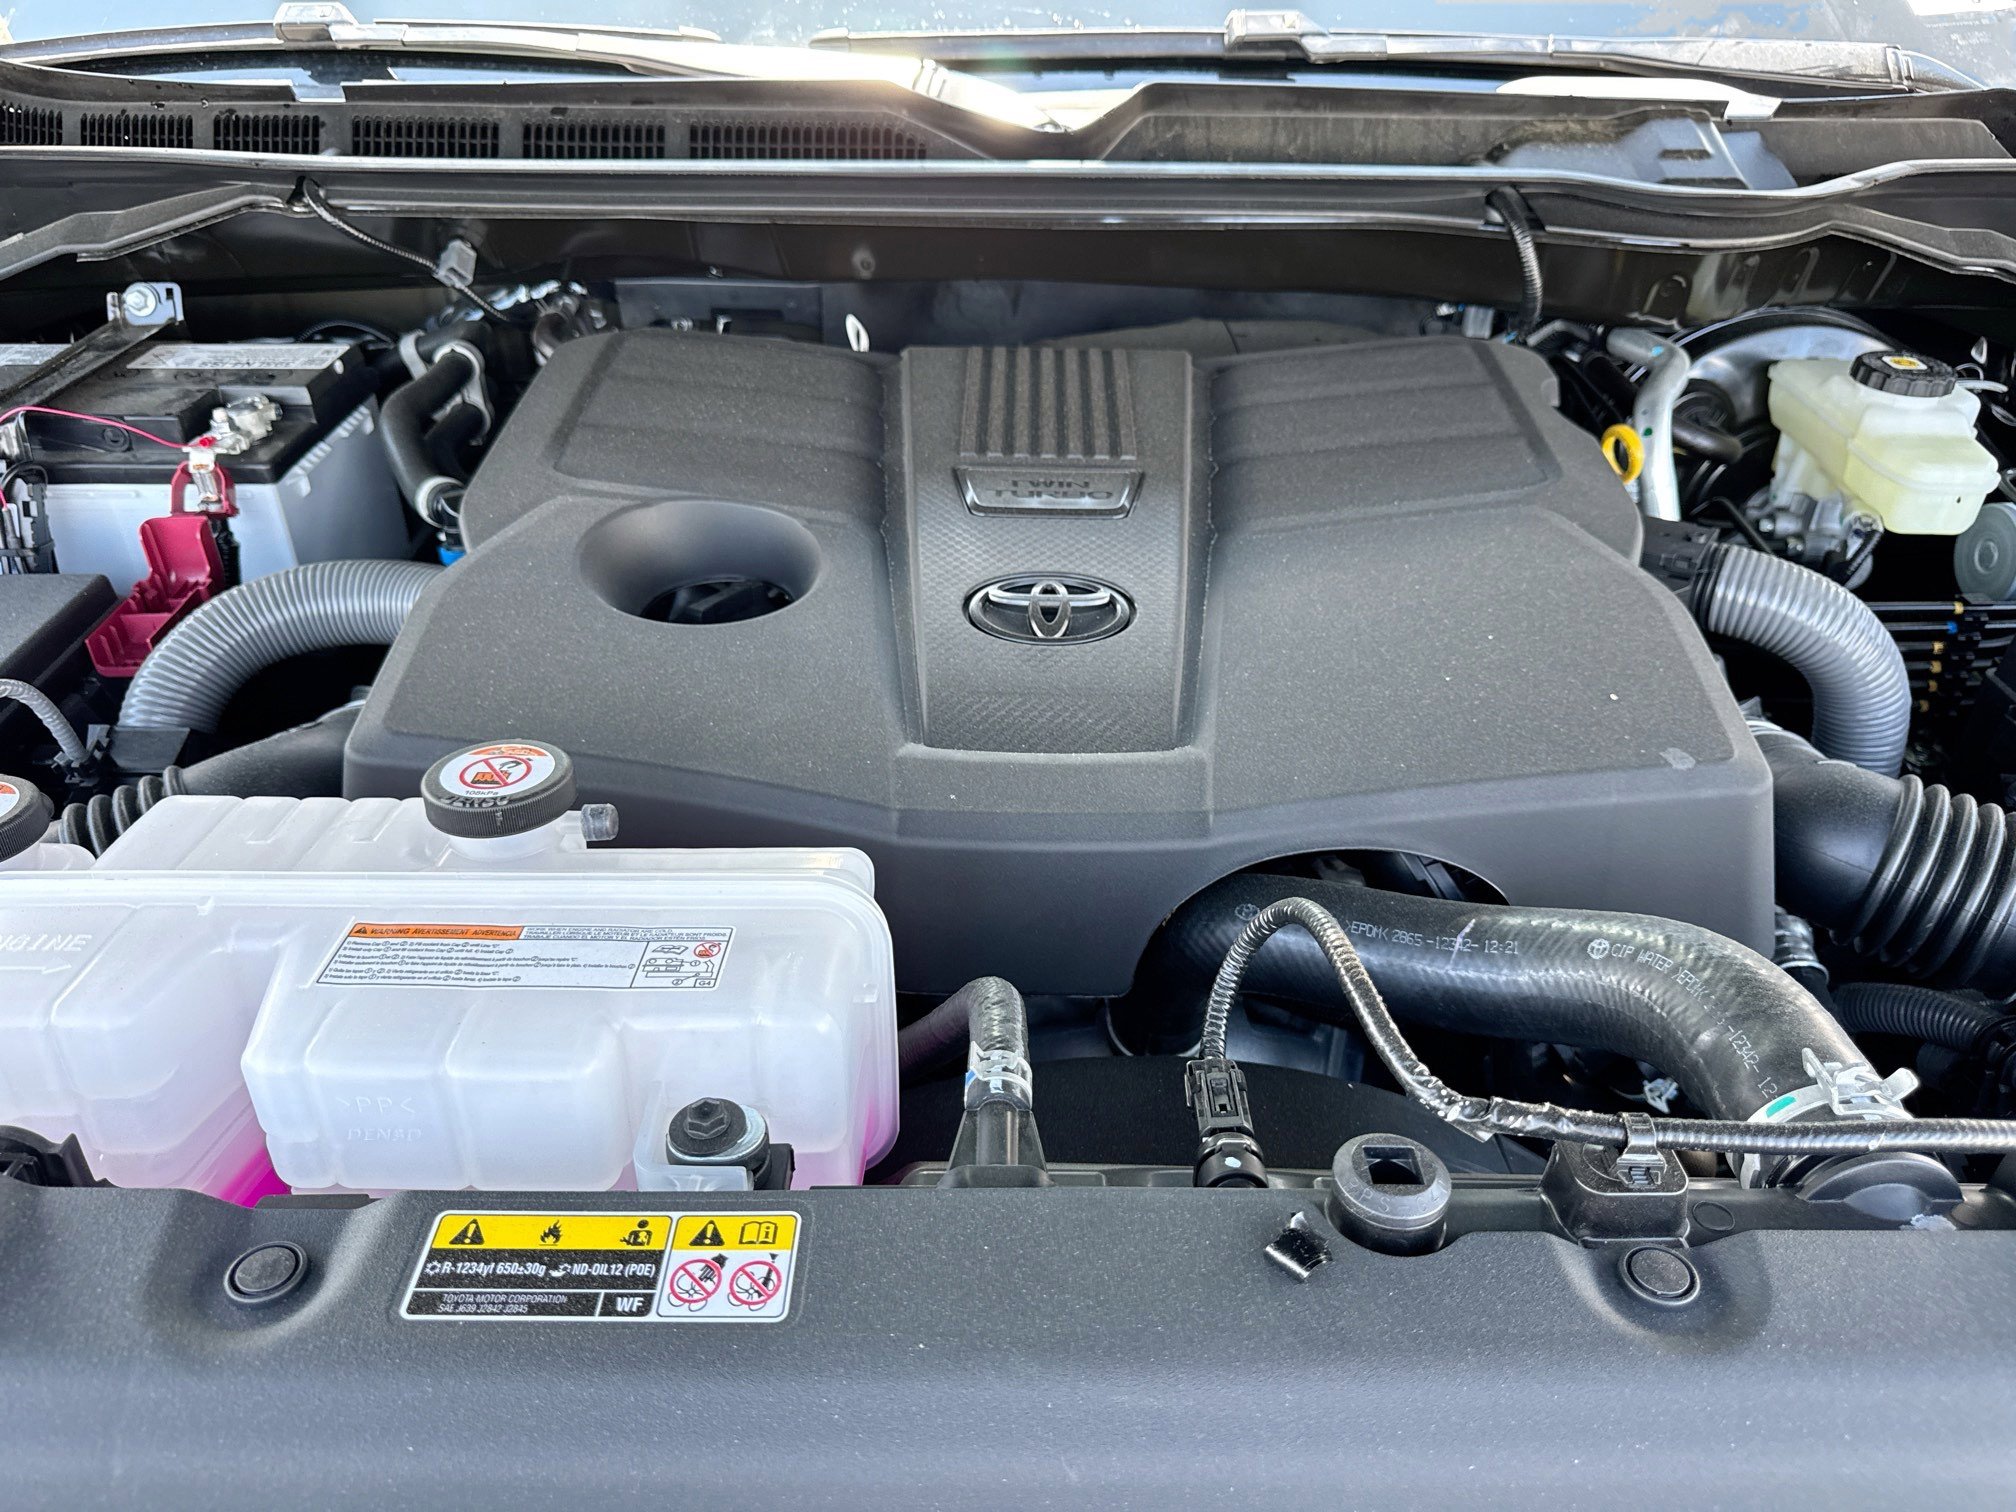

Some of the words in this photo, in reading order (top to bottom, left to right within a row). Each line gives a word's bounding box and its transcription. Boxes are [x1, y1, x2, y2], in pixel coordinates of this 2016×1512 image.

[1010, 479, 1090, 489] TWIN
[370, 927, 410, 935] WARNING
[411, 927, 470, 936] AVERTISSEMENT
[1391, 929, 1423, 946] 2865
[1611, 943, 1635, 957] CIP
[1637, 948, 1674, 974] WATER
[440, 1261, 495, 1275] R-1234yf
[496, 1262, 546, 1277] 650±30g
[572, 1263, 624, 1275] ND-OIL12
[625, 1263, 656, 1278] (POE)
[442, 1293, 474, 1302] TOYOTA
[476, 1294, 507, 1303] MOTOR
[508, 1294, 567, 1304] CORPORATION
[615, 1297, 645, 1311] WF
[437, 1304, 454, 1312] SAE
